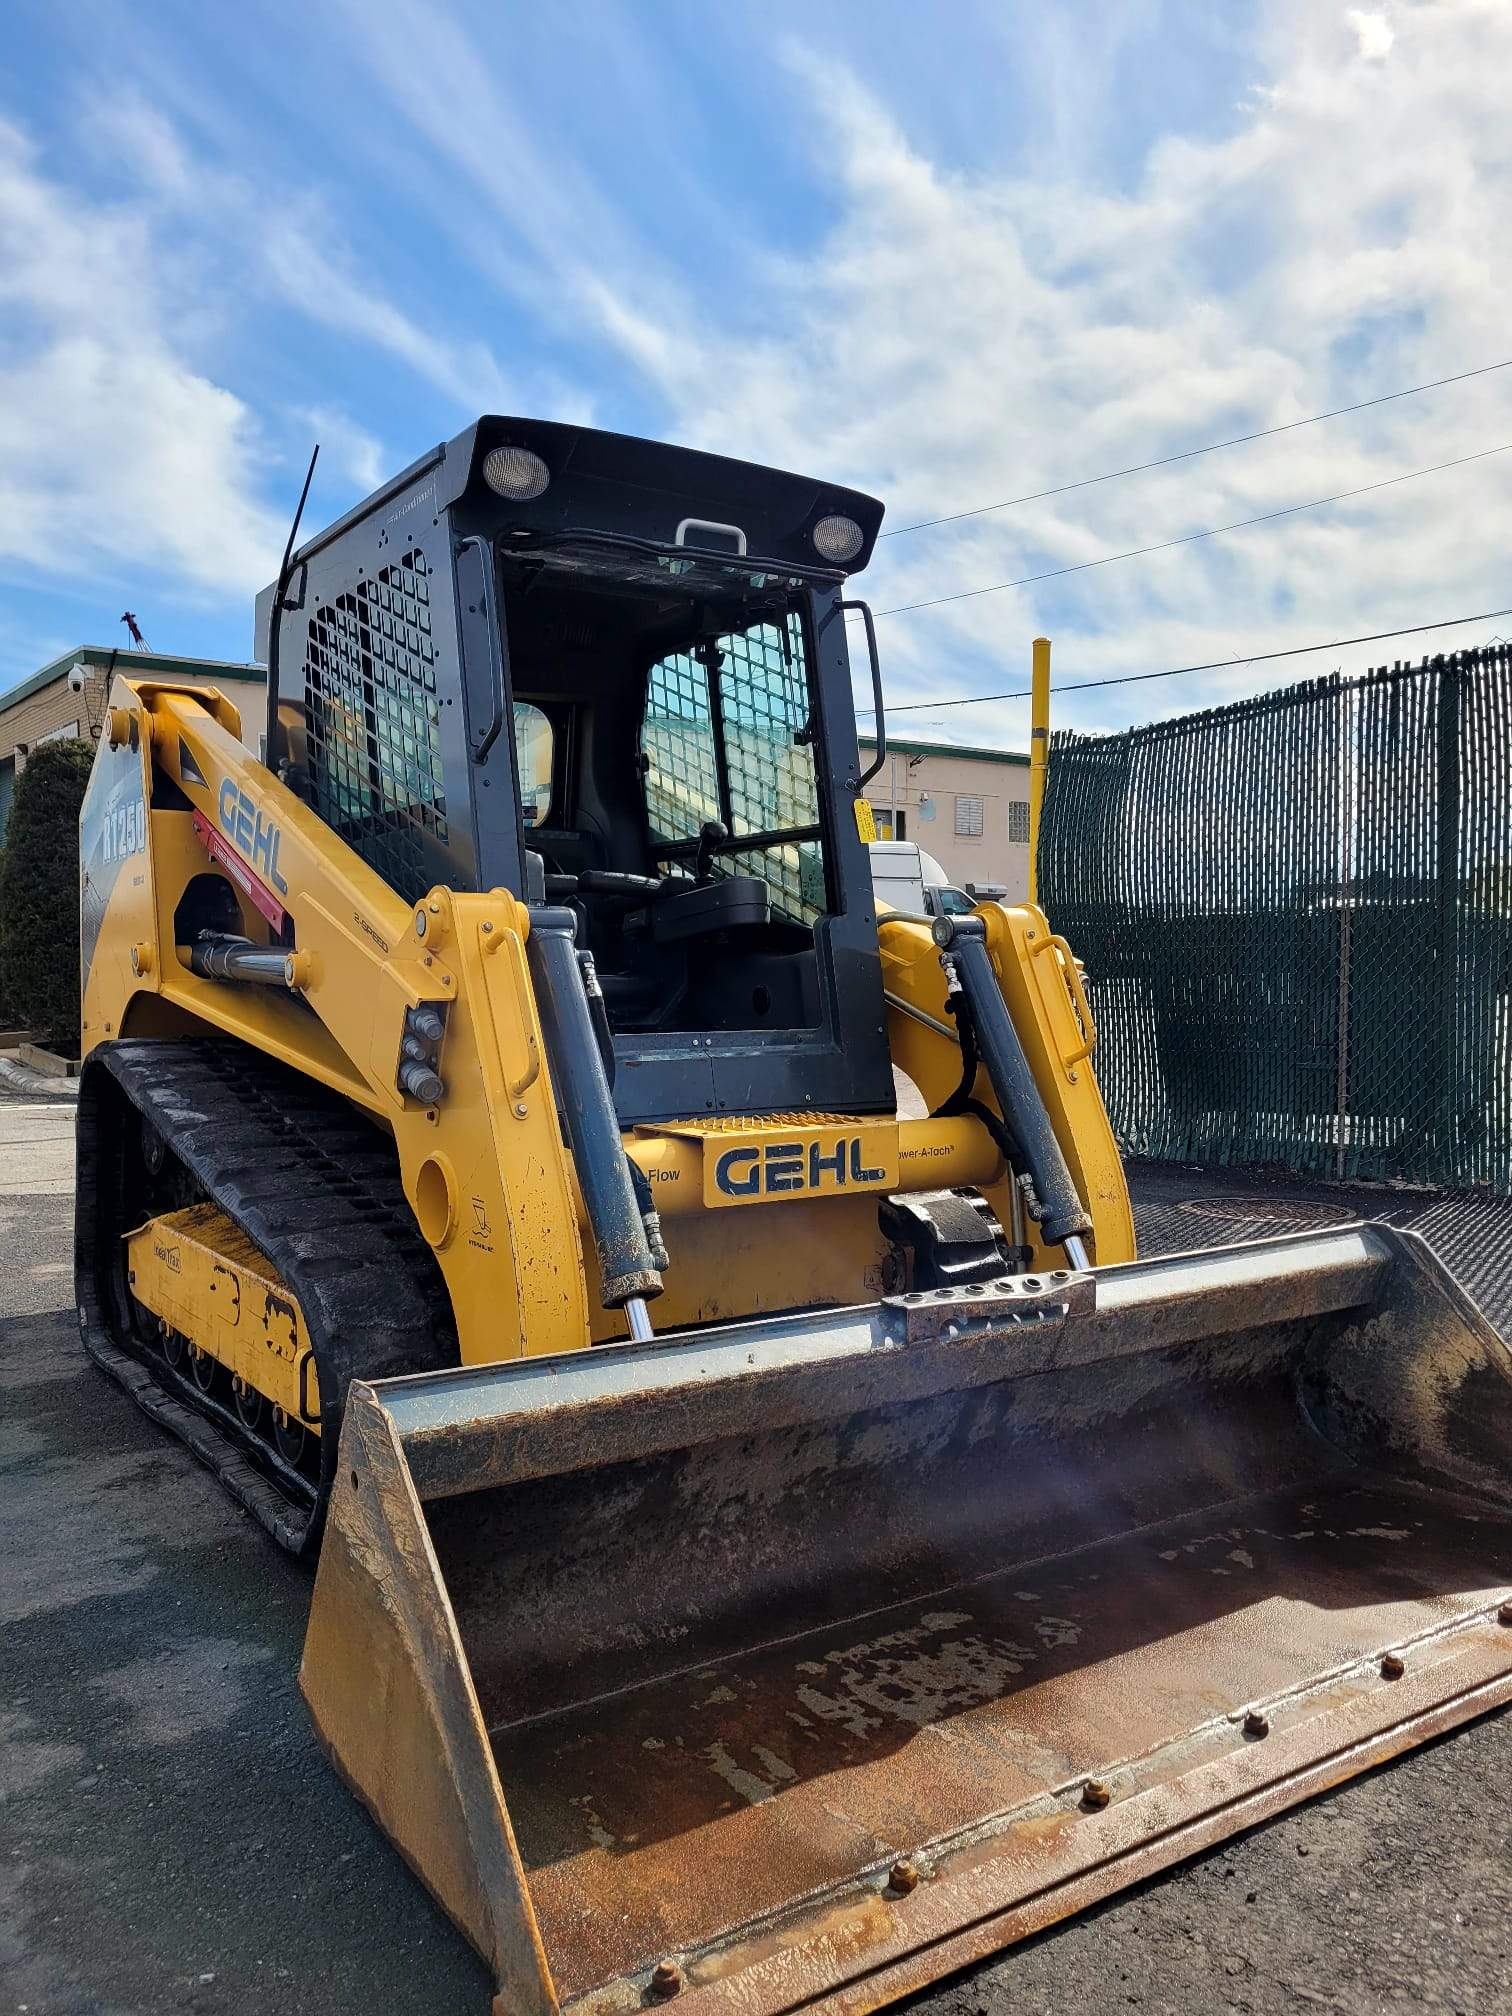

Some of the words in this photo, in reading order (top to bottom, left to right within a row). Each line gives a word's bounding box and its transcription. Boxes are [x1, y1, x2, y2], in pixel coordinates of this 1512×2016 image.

[103, 797, 146, 865] RT250
[219, 776, 288, 896] GEHL
[714, 1136, 886, 1197] GEHL
